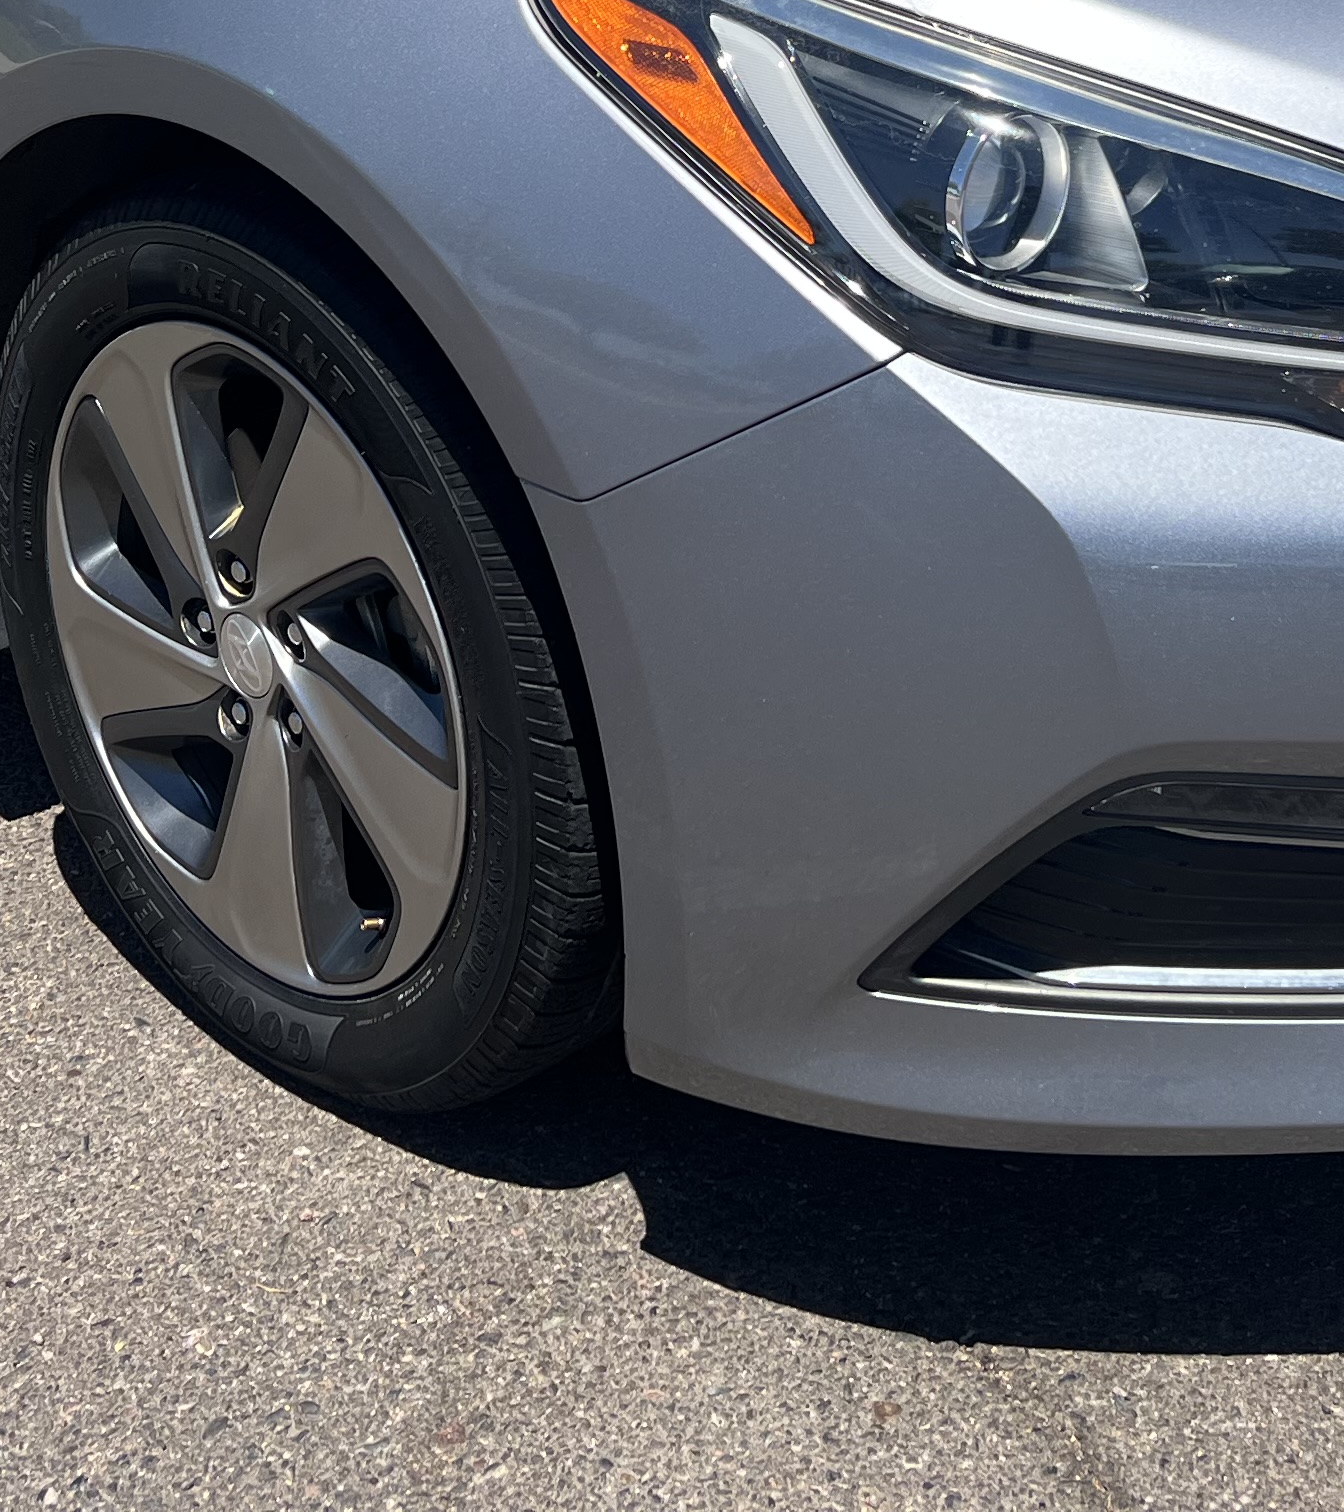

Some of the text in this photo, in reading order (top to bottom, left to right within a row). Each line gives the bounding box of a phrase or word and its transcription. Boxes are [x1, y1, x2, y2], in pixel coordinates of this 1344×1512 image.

[177, 258, 356, 403] RELIANT
[91, 828, 313, 1063] GOODYEAR
[459, 758, 508, 998] ALL-SEASON
